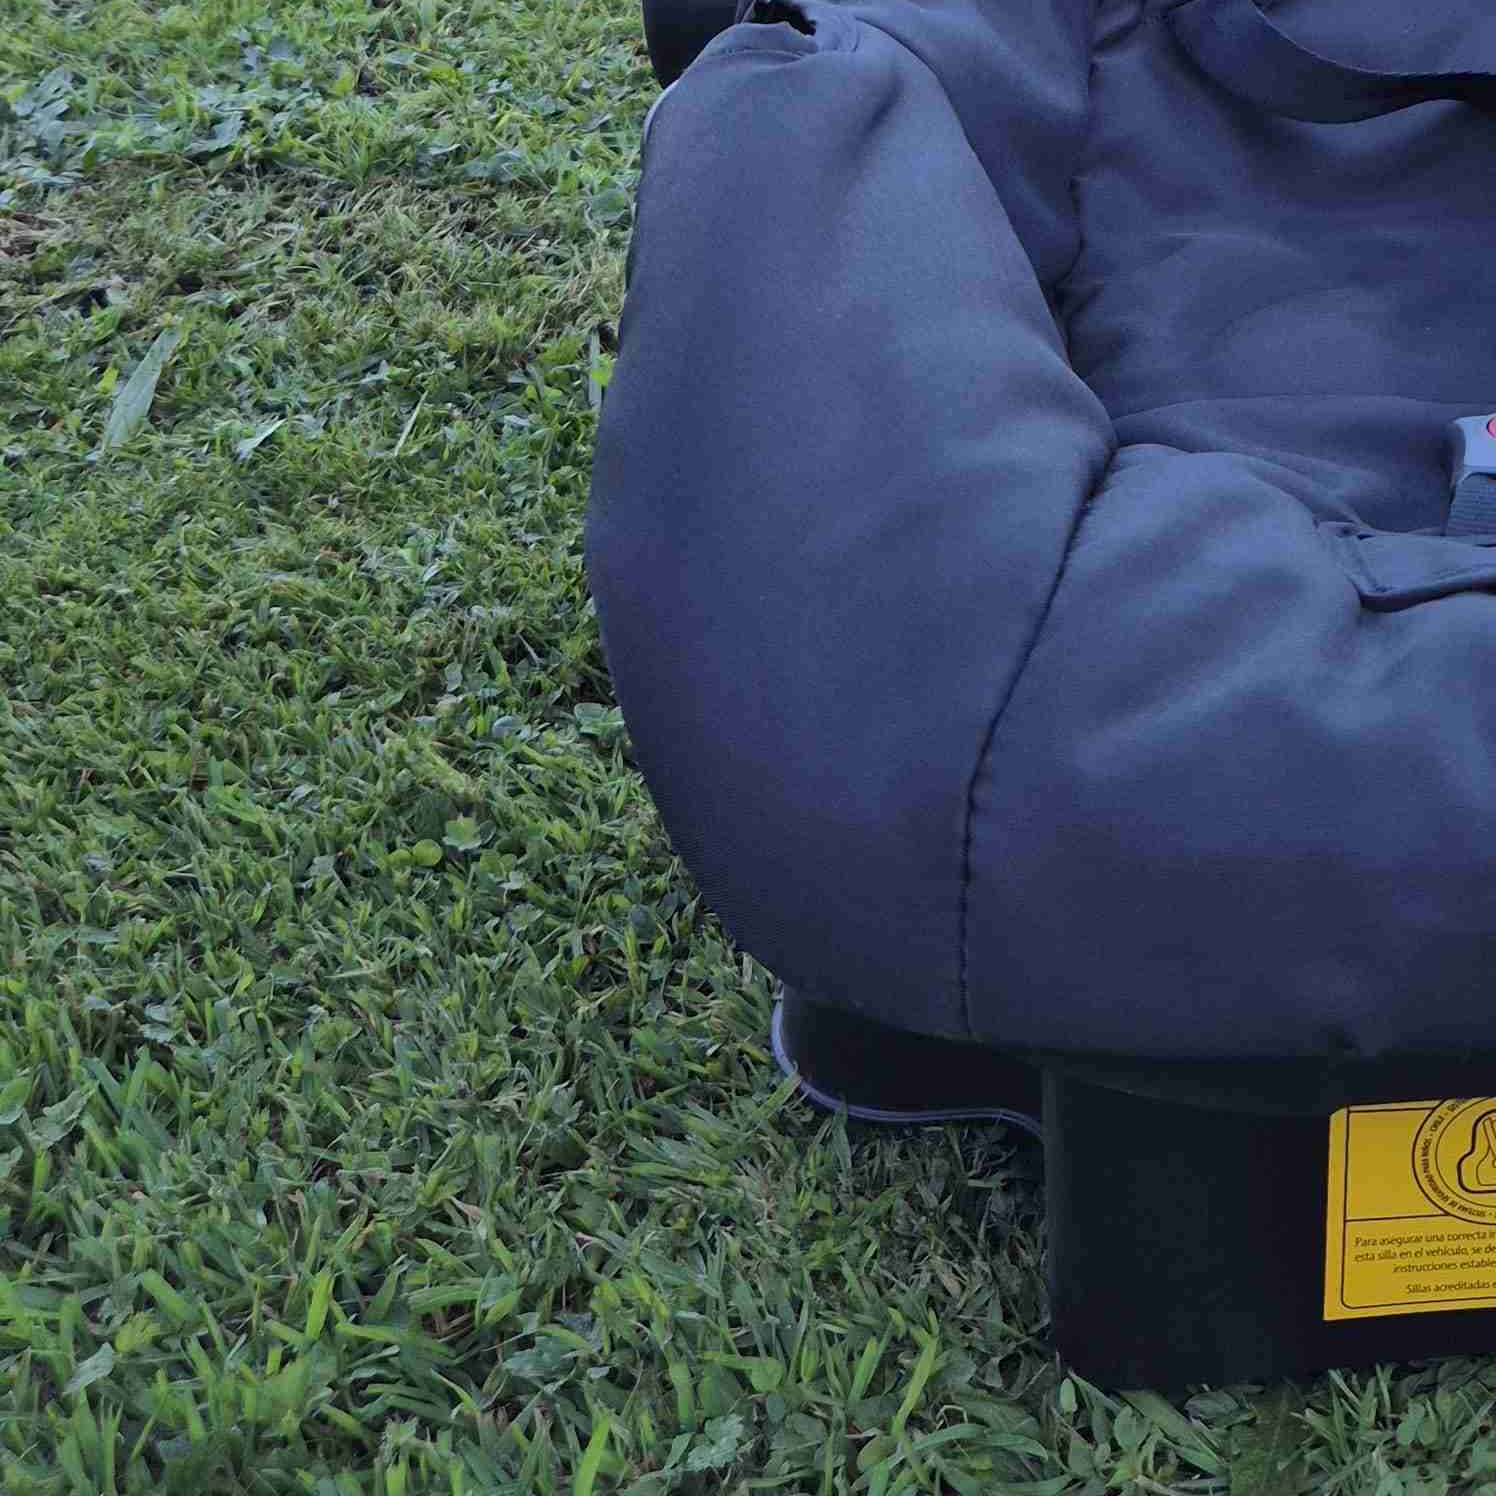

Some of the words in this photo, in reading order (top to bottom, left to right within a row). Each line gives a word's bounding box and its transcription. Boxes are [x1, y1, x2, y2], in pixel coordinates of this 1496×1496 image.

[1355, 1236, 1378, 1247] Para
[1379, 1235, 1423, 1248] asegurar
[1424, 1233, 1445, 1242] una
[1447, 1231, 1487, 1241] correcta
[1354, 1252, 1376, 1262] esta
[1377, 1249, 1398, 1260] silla
[1399, 1250, 1412, 1259] en
[1414, 1247, 1424, 1258] el
[1471, 1246, 1483, 1255] se
[1393, 1261, 1458, 1273] instrucciones
[1406, 1283, 1432, 1294] Sillas
[1433, 1280, 1490, 1293] acreditadas
